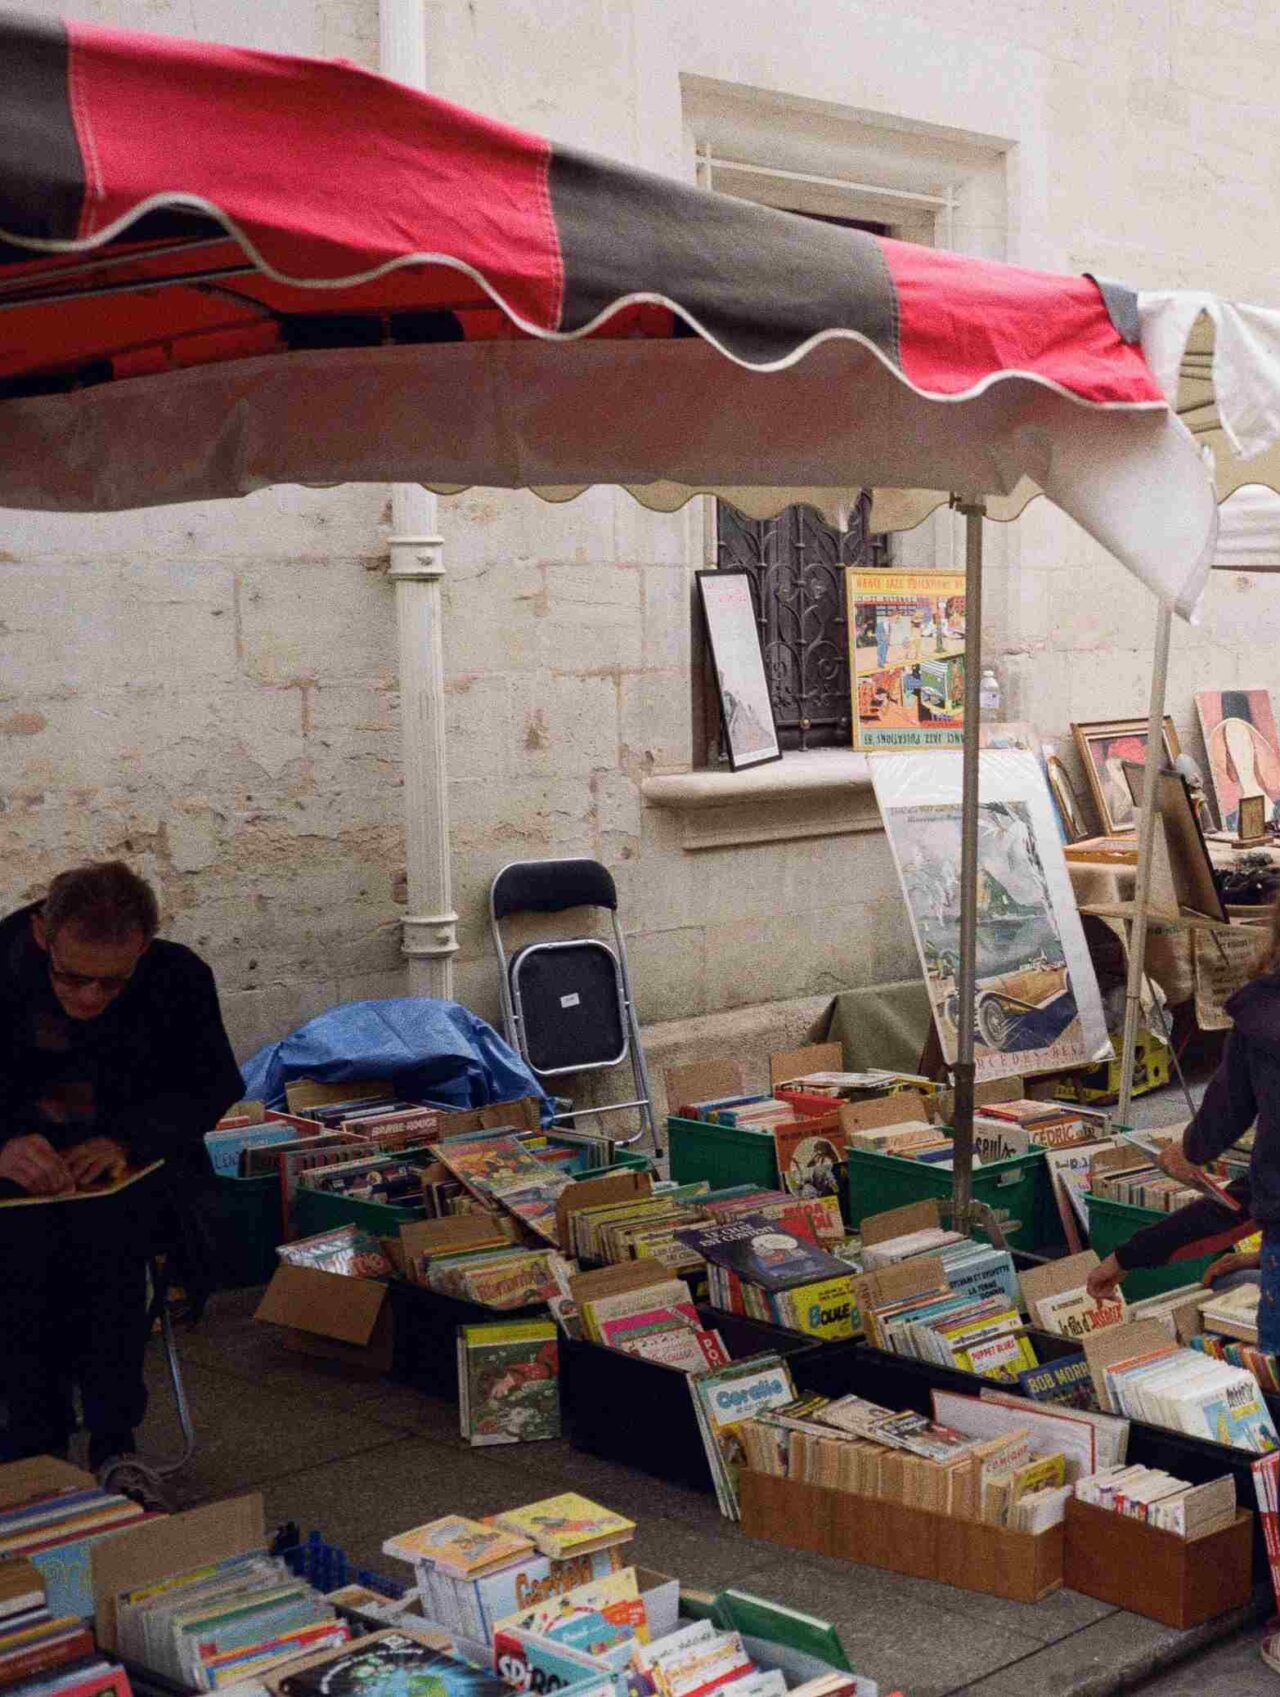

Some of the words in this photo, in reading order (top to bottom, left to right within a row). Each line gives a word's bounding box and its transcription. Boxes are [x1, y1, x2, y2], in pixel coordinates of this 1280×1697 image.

[924, 733, 942, 747] JAZZ
[808, 1302, 850, 1329] BOULE
[1028, 1371, 1056, 1393] BOB
